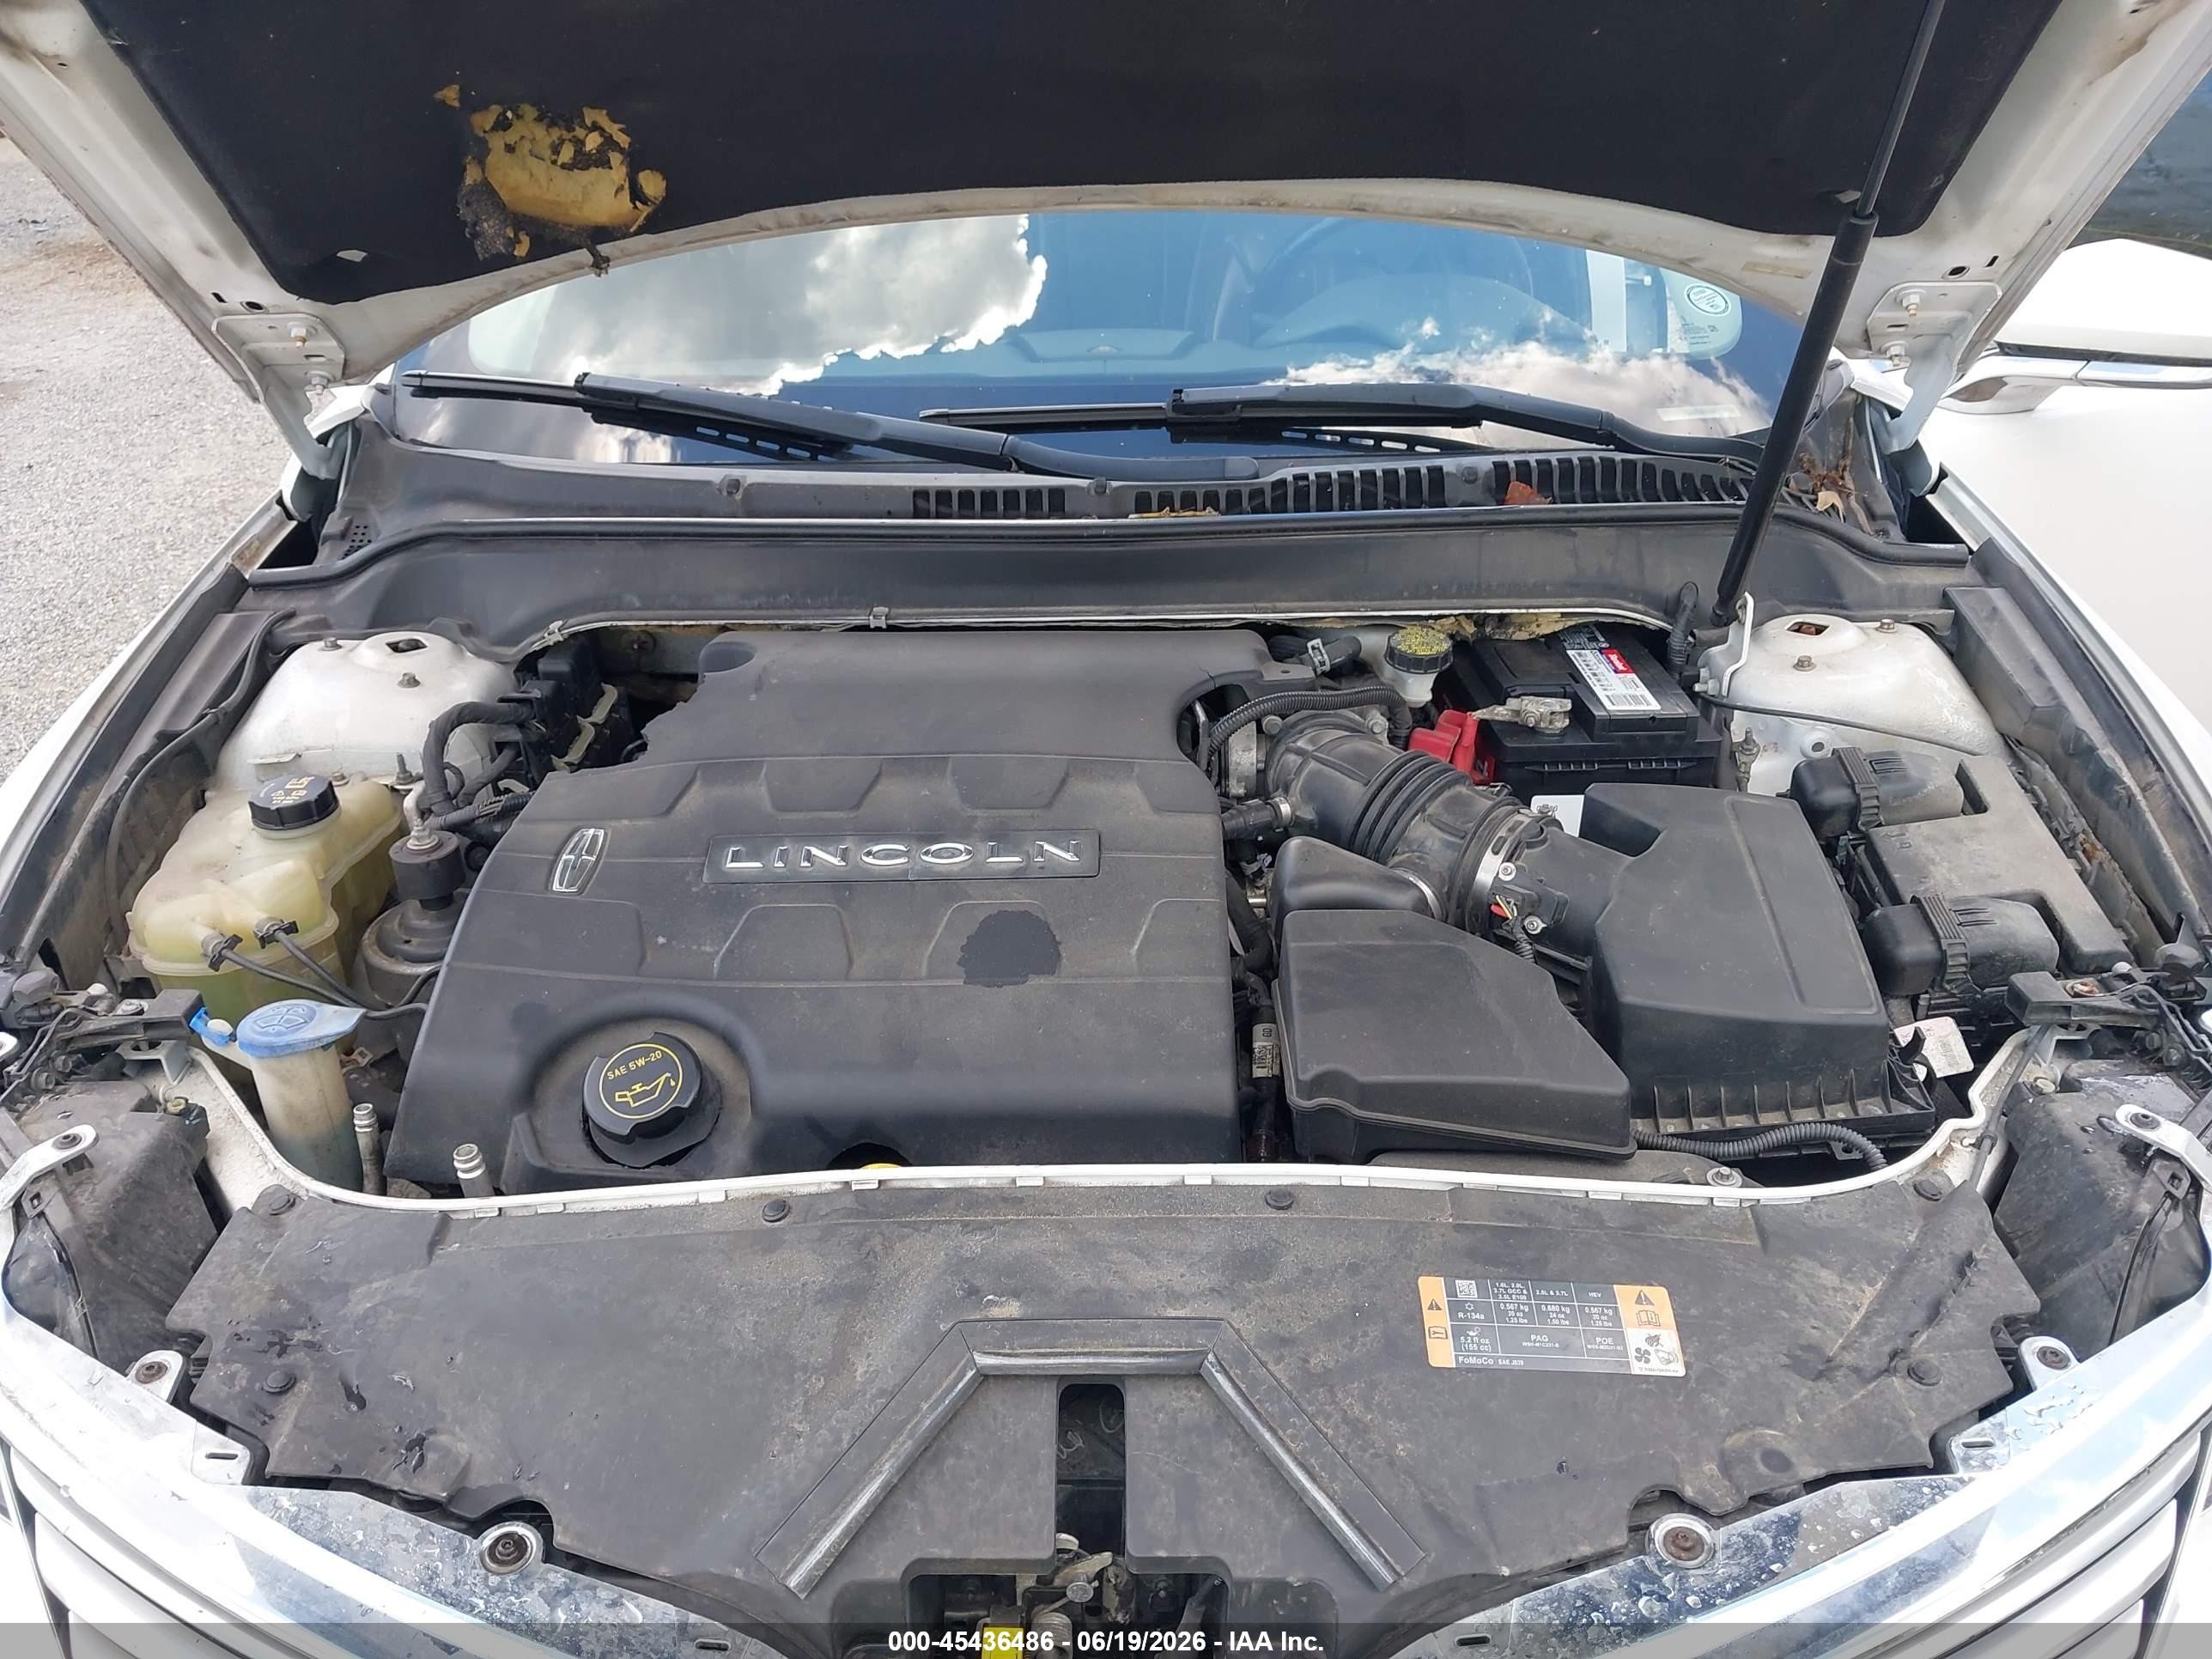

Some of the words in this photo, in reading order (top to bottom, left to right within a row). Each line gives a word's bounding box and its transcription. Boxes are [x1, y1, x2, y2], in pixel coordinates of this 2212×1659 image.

[725, 840, 1080, 870] LINCOLN
[606, 1065, 629, 1080] SAE
[629, 1050, 662, 1071] 5W-20
[1519, 1304, 1529, 1312] kg
[1561, 1305, 1571, 1314] kg
[1603, 1307, 1613, 1316] kg
[1530, 1334, 1549, 1342] PAG
[1595, 1336, 1614, 1346] POE
[1462, 1343, 1478, 1352] (155
[1458, 1356, 1494, 1364] FoMoCo
